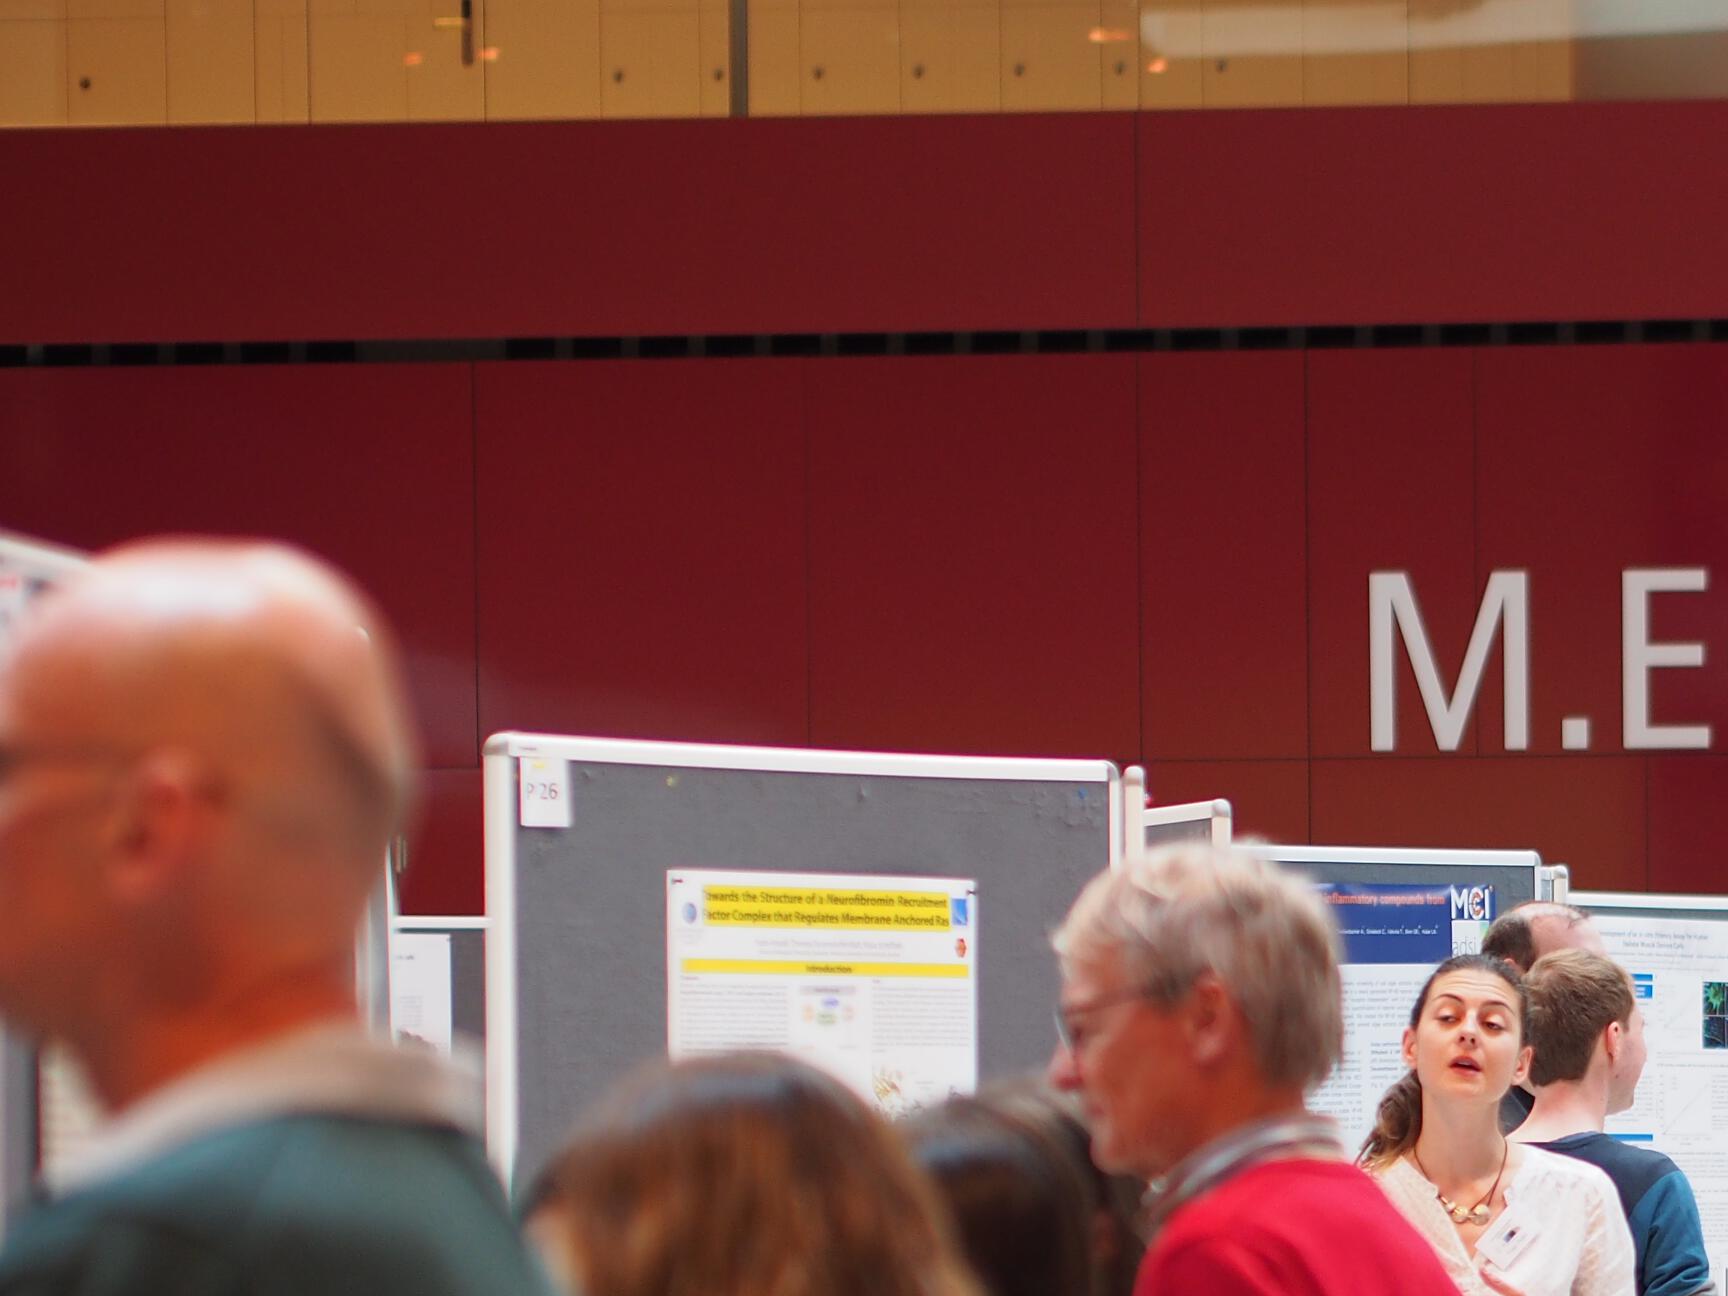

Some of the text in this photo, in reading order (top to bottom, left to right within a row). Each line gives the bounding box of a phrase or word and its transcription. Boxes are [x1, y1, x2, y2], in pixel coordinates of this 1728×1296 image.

[539, 782, 559, 800] 26
[760, 890, 803, 904] Structure
[827, 893, 895, 907] Neurofibromin
[898, 895, 948, 909] Recruitment
[732, 909, 771, 923] Complex
[774, 910, 792, 922] that
[794, 911, 839, 925] Regulates
[841, 912, 891, 925] Membrane
[893, 914, 934, 927] Anchored
